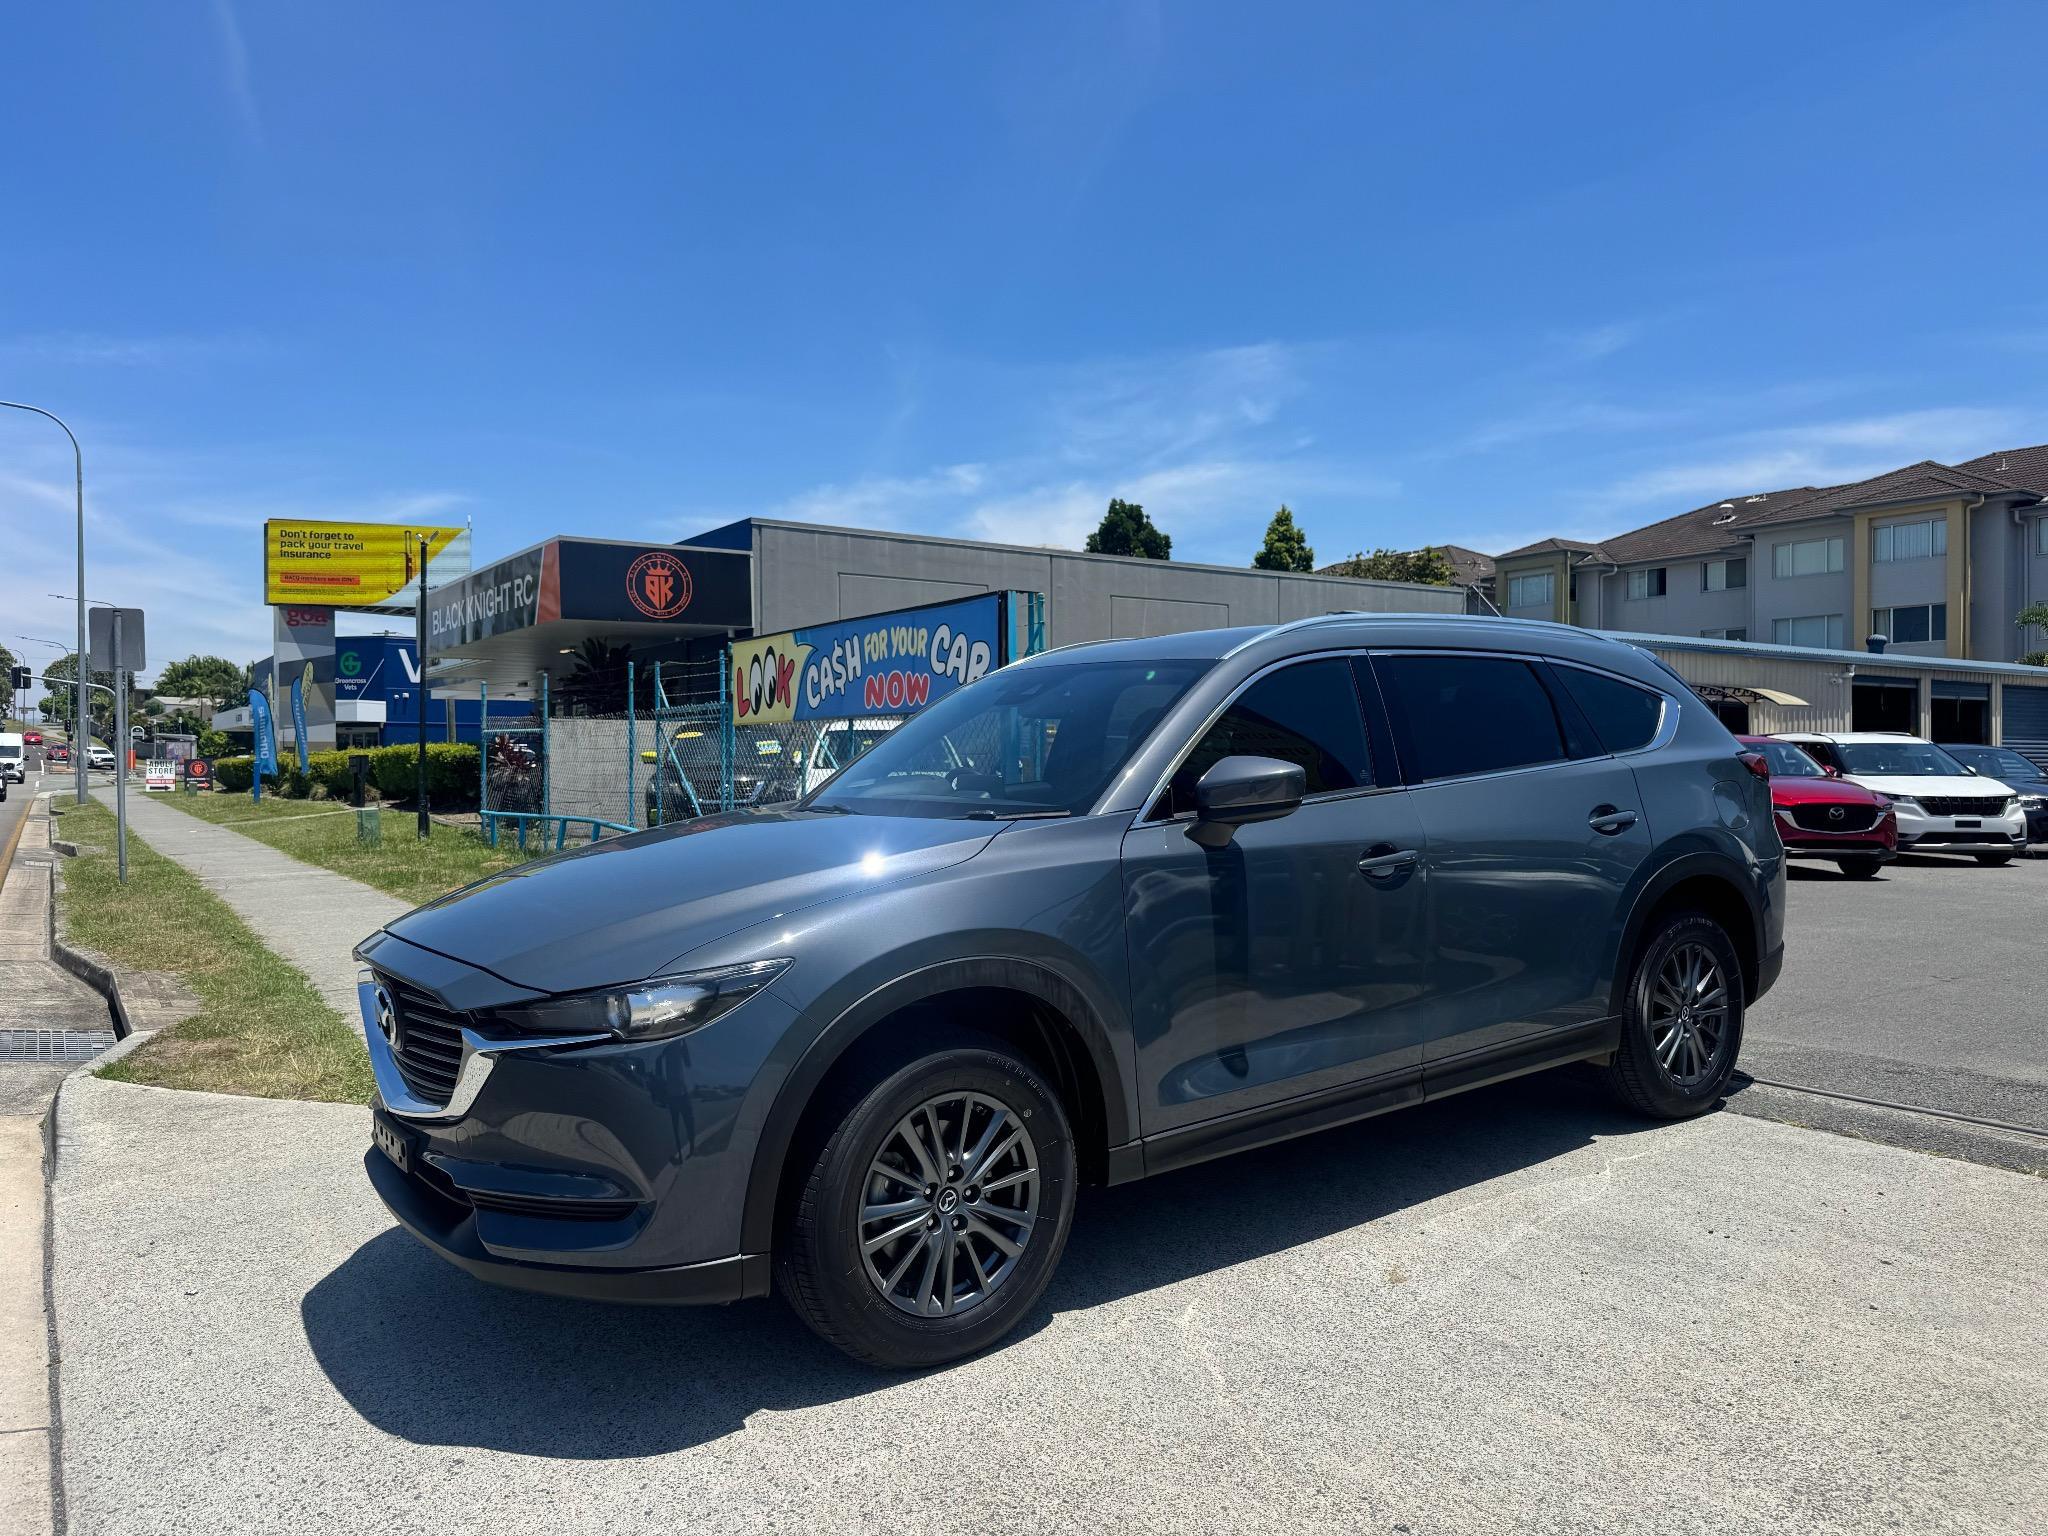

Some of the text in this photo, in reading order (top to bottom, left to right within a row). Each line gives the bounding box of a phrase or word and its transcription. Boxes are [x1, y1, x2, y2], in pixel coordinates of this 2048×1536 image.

[280, 530, 354, 540] Don't forget to
[280, 540, 364, 550] pack your travel
[280, 550, 332, 559] insurance
[432, 574, 534, 636] BLACK KNIGHT RC
[806, 623, 992, 710] CA$H FOR YOUR CAR
[335, 677, 367, 685] Greencross
[736, 646, 795, 718] LOOK
[863, 670, 931, 710] NOW
[148, 767, 174, 775] STORE
